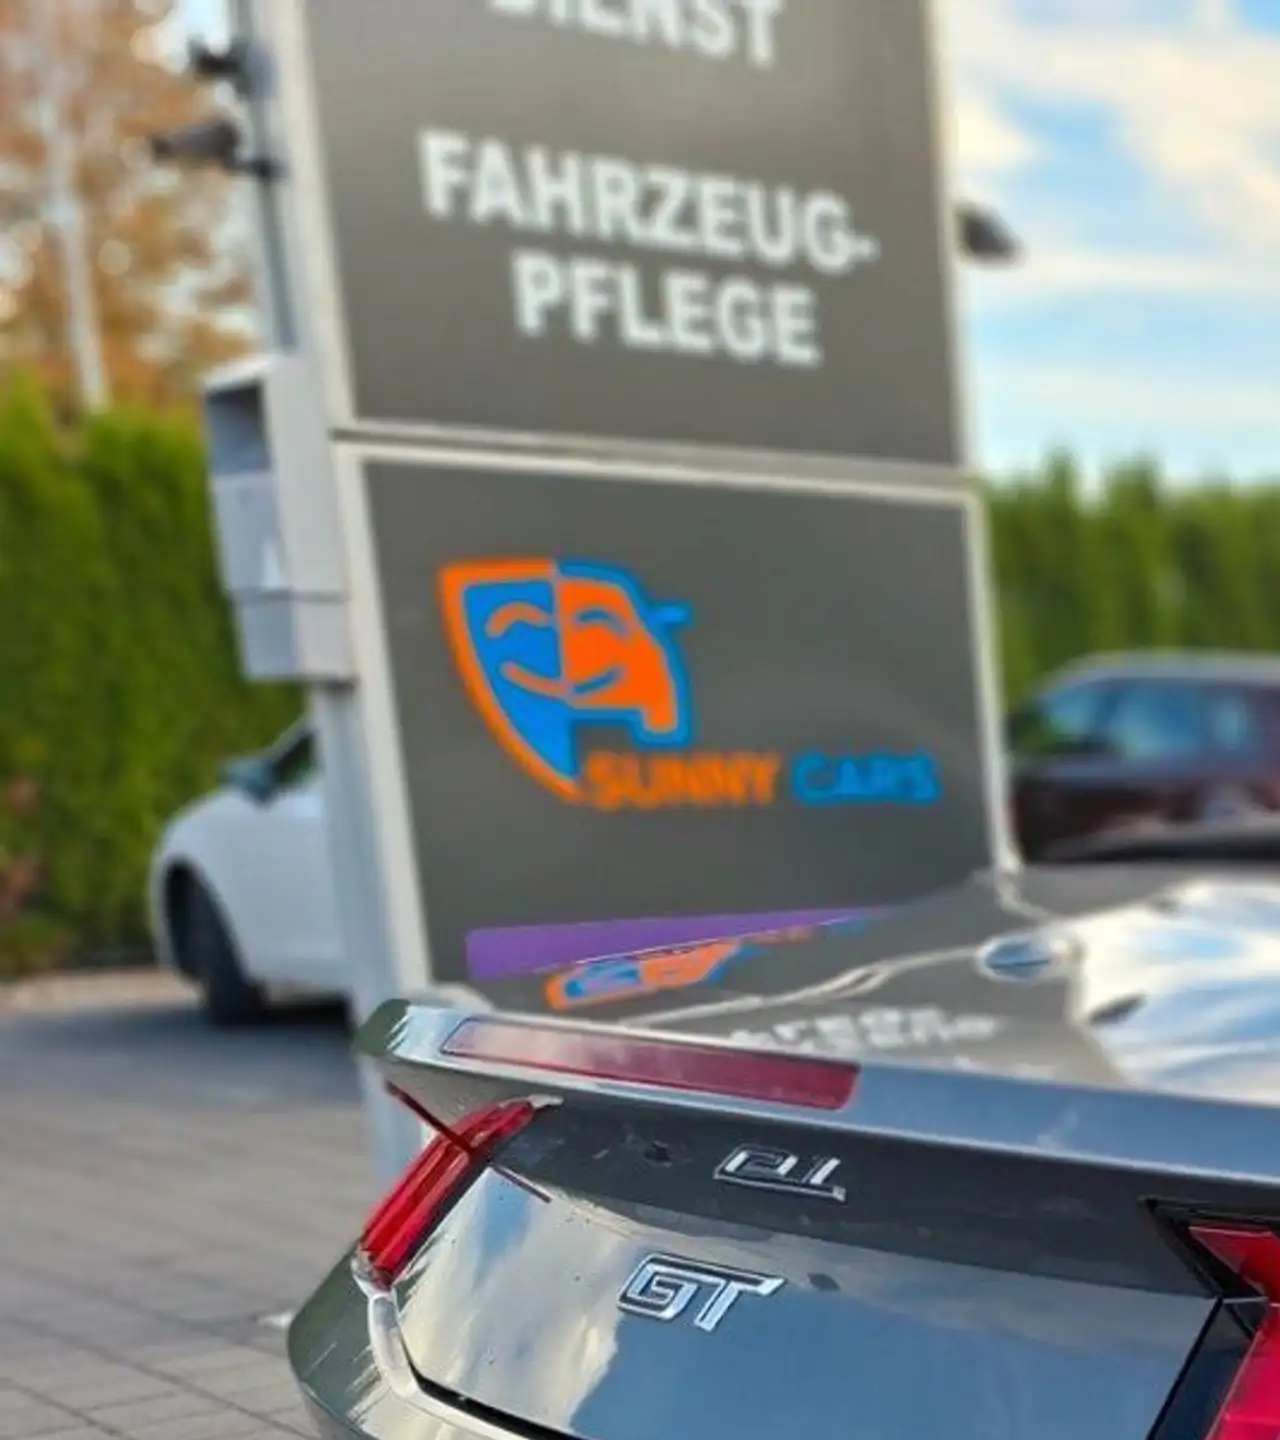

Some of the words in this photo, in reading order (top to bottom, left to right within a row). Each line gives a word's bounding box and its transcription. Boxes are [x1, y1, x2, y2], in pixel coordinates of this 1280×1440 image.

[492, 0, 784, 67] NST
[418, 129, 881, 273] FAHRZEUG-
[513, 248, 824, 367] PFLEGE
[585, 751, 780, 810] SUNNY
[793, 751, 942, 805] CARS
[617, 1252, 788, 1333] GT
